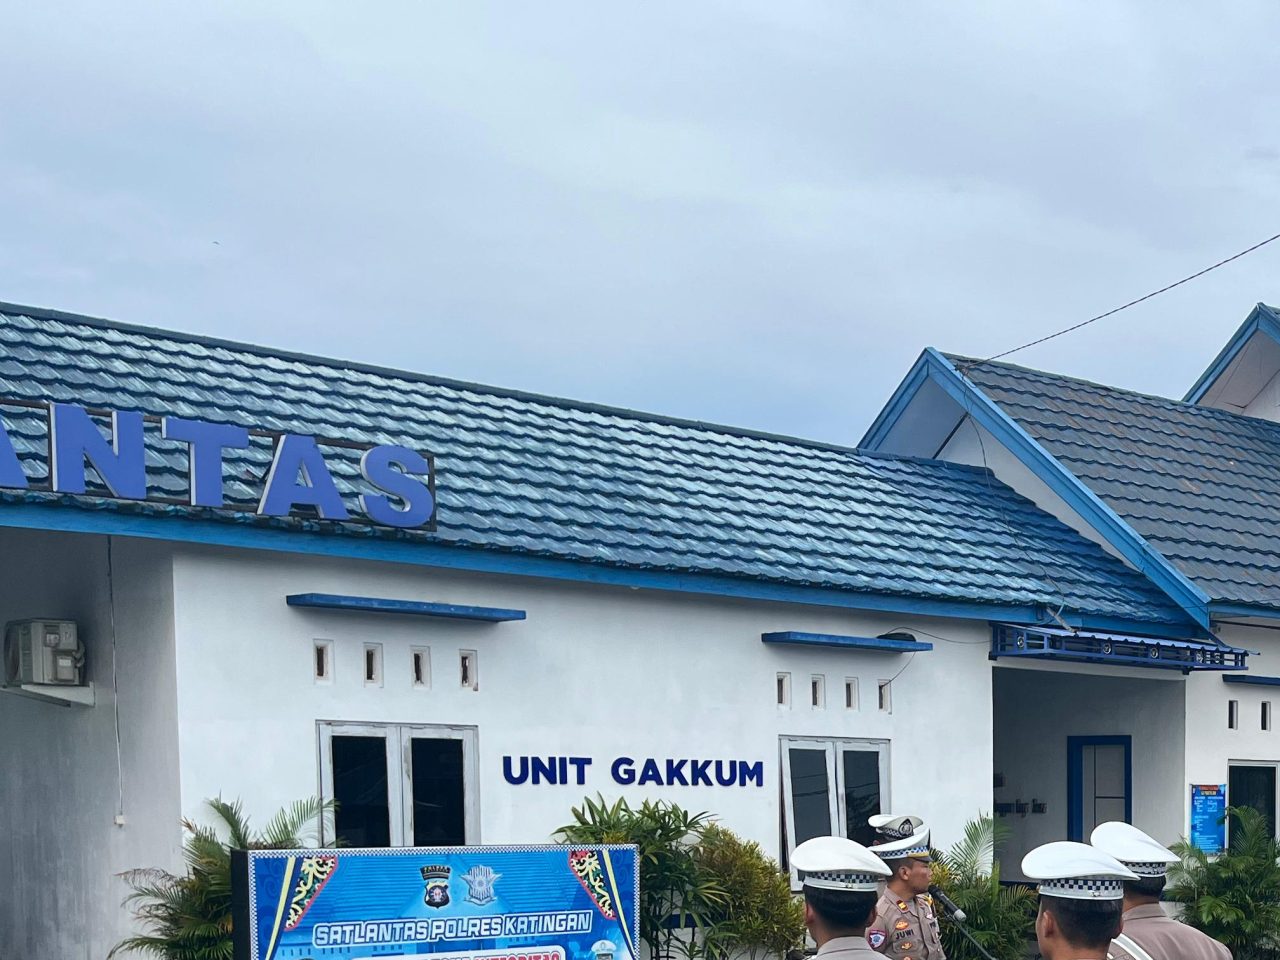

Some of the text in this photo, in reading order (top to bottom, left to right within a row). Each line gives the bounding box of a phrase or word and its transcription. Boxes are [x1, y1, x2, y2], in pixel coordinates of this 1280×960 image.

[502, 756, 764, 787] UNIT GAKKUM
[316, 912, 591, 945] SATLANTAS POLRES KATINGAN
